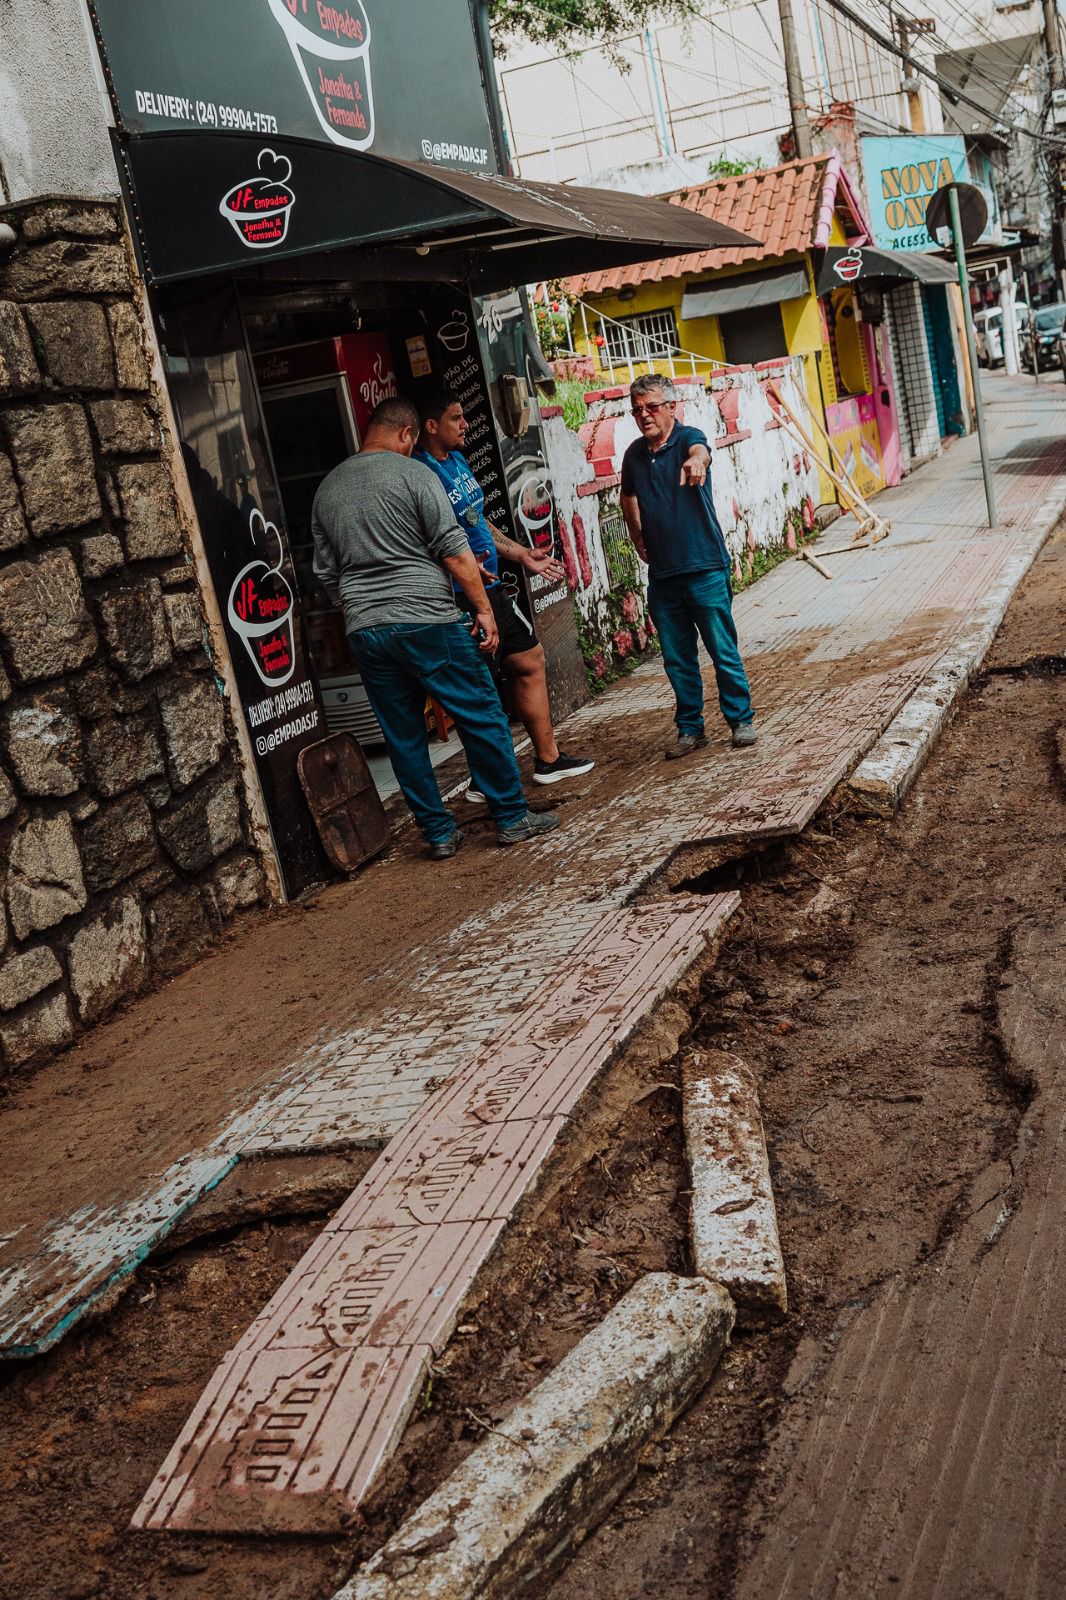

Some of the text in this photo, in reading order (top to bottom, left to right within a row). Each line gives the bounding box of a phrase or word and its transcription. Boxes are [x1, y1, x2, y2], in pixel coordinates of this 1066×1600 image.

[352, 80, 364, 101] &
[135, 89, 279, 135] DELIVERY: (24) 99904-7573
[324, 96, 367, 129] Fernanda
[432, 141, 489, 165] @EMPADASJF
[880, 157, 956, 200] NOVA
[231, 187, 289, 212] JF Empadas
[885, 194, 933, 231] ON
[243, 218, 275, 234] Jonatha
[247, 227, 282, 242] Fernanda
[266, 710, 319, 751] @EMPADASJF
